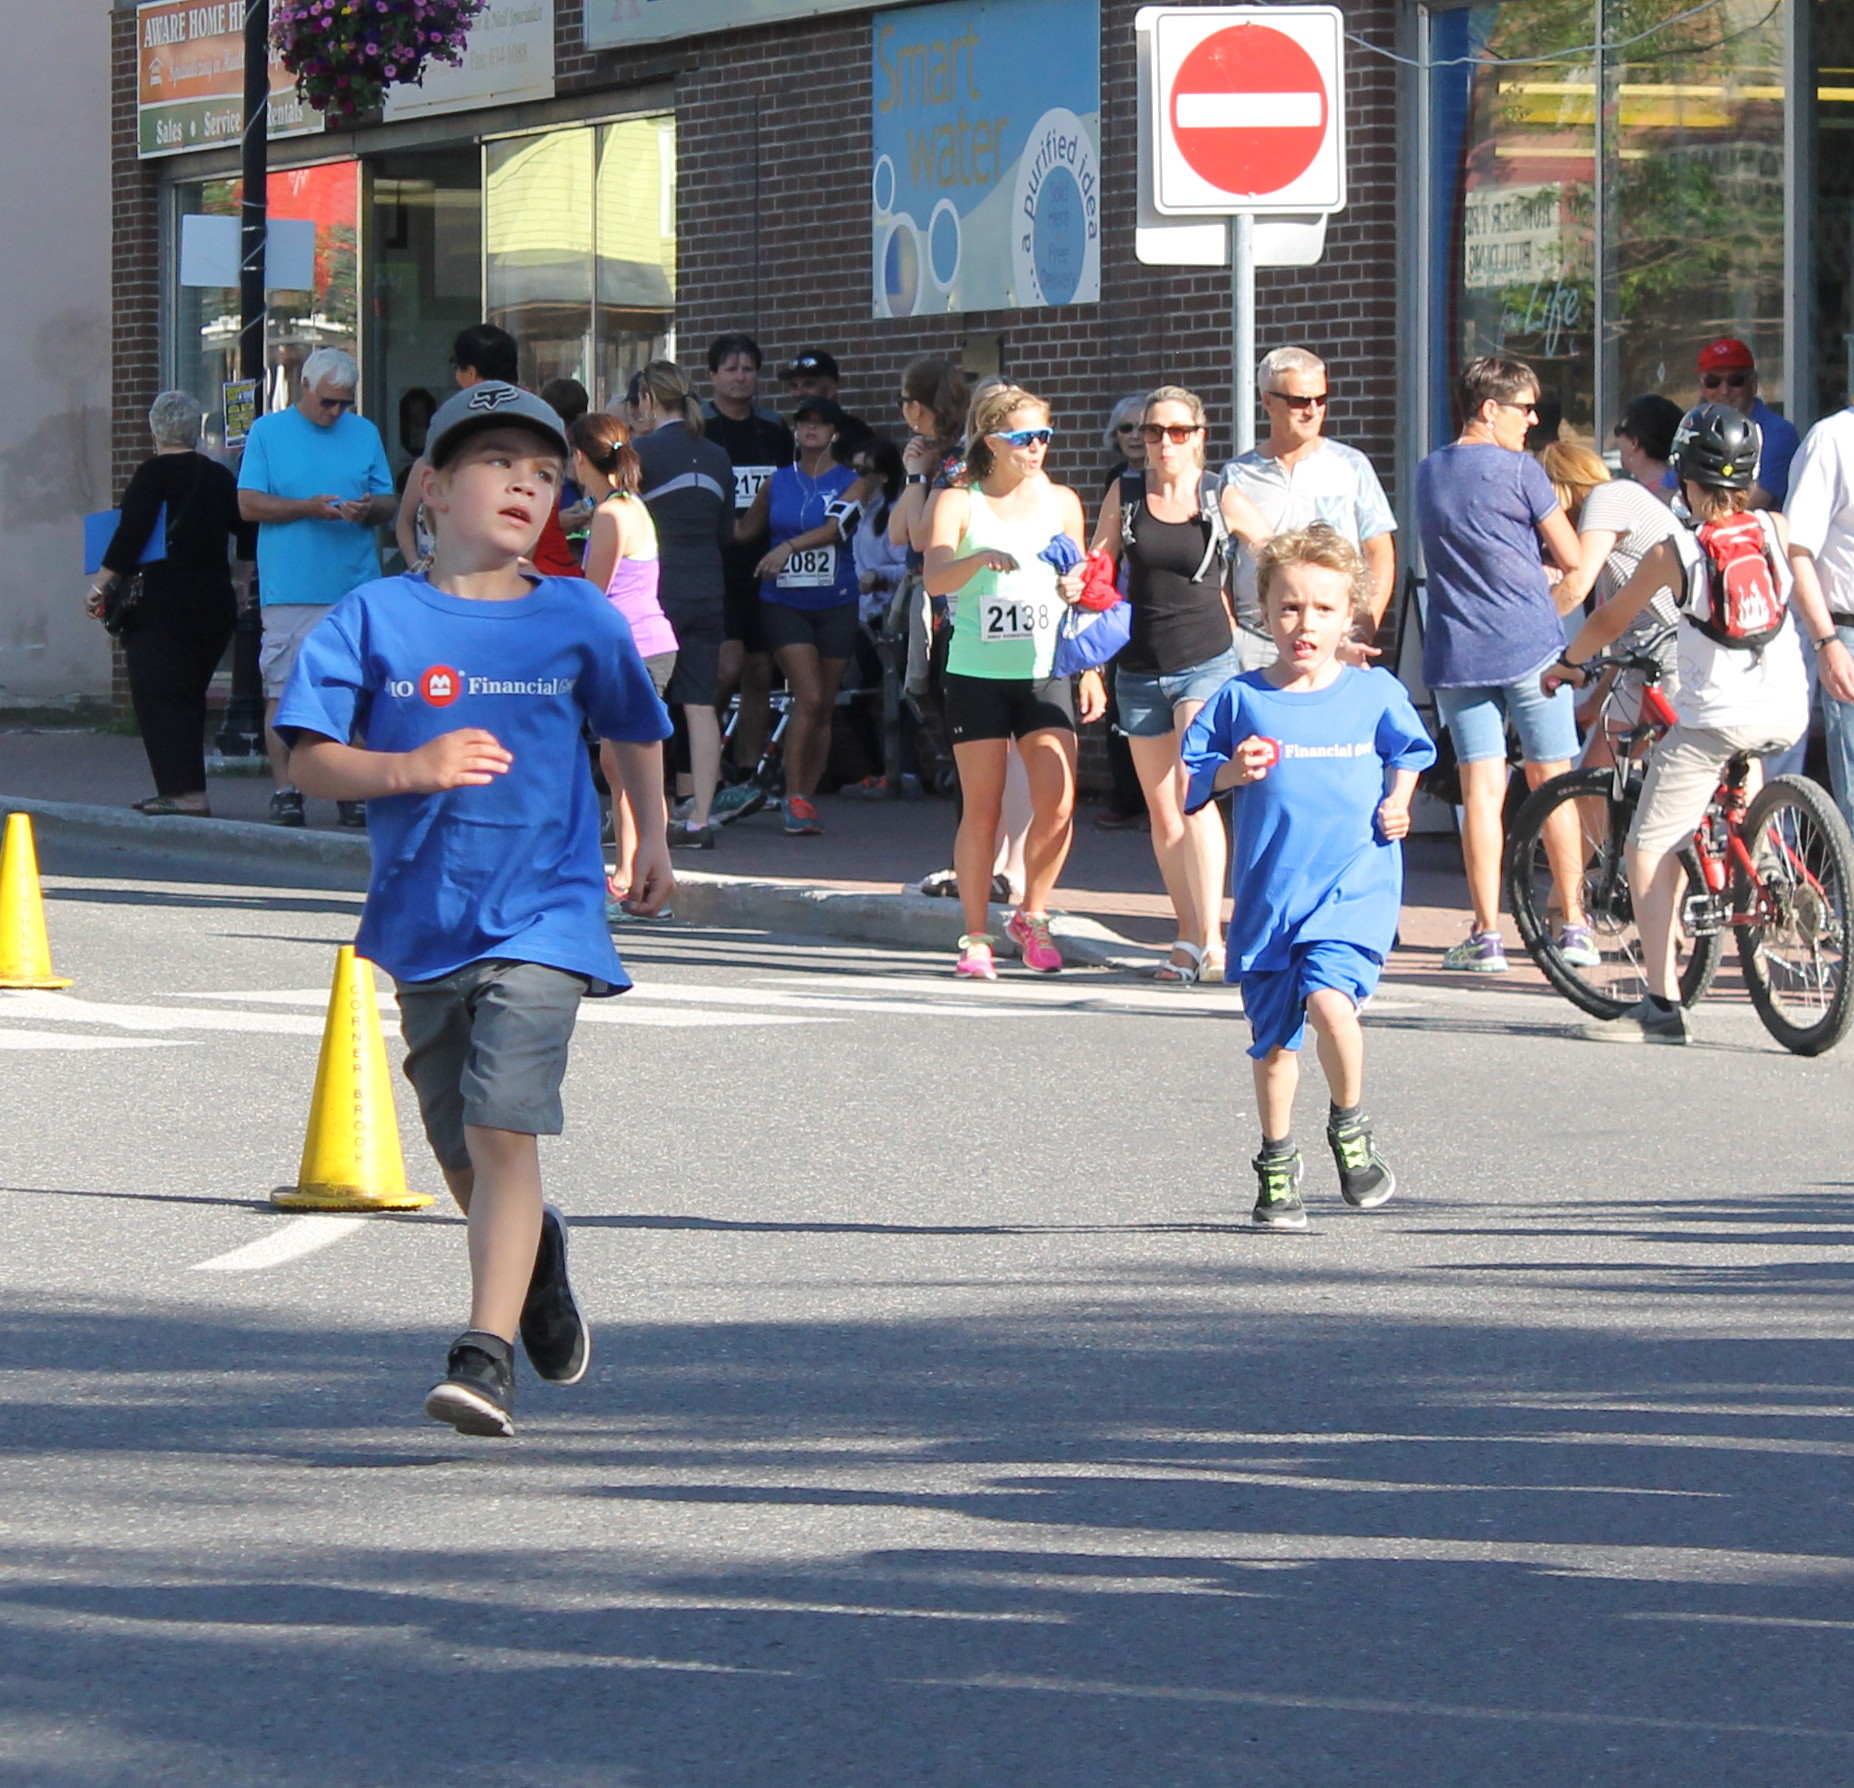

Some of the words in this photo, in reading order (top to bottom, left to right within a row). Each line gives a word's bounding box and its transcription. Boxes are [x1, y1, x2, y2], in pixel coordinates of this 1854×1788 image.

[144, 11, 185, 48] AWARE
[189, 4, 225, 39] HOME
[879, 20, 981, 112] Smart
[156, 120, 183, 145] Sales
[203, 110, 241, 137] Service
[907, 107, 1010, 190] water
[1024, 128, 1079, 222] purified
[1079, 154, 1097, 240] idea
[1021, 232, 1031, 253] a
[734, 474, 771, 494] 217
[988, 604, 1049, 632] 2138
[468, 677, 558, 696] Financial
[1285, 743, 1353, 759] Financial
[350, 985, 362, 1073] CORNER
[353, 1089, 366, 1163] BROOK
